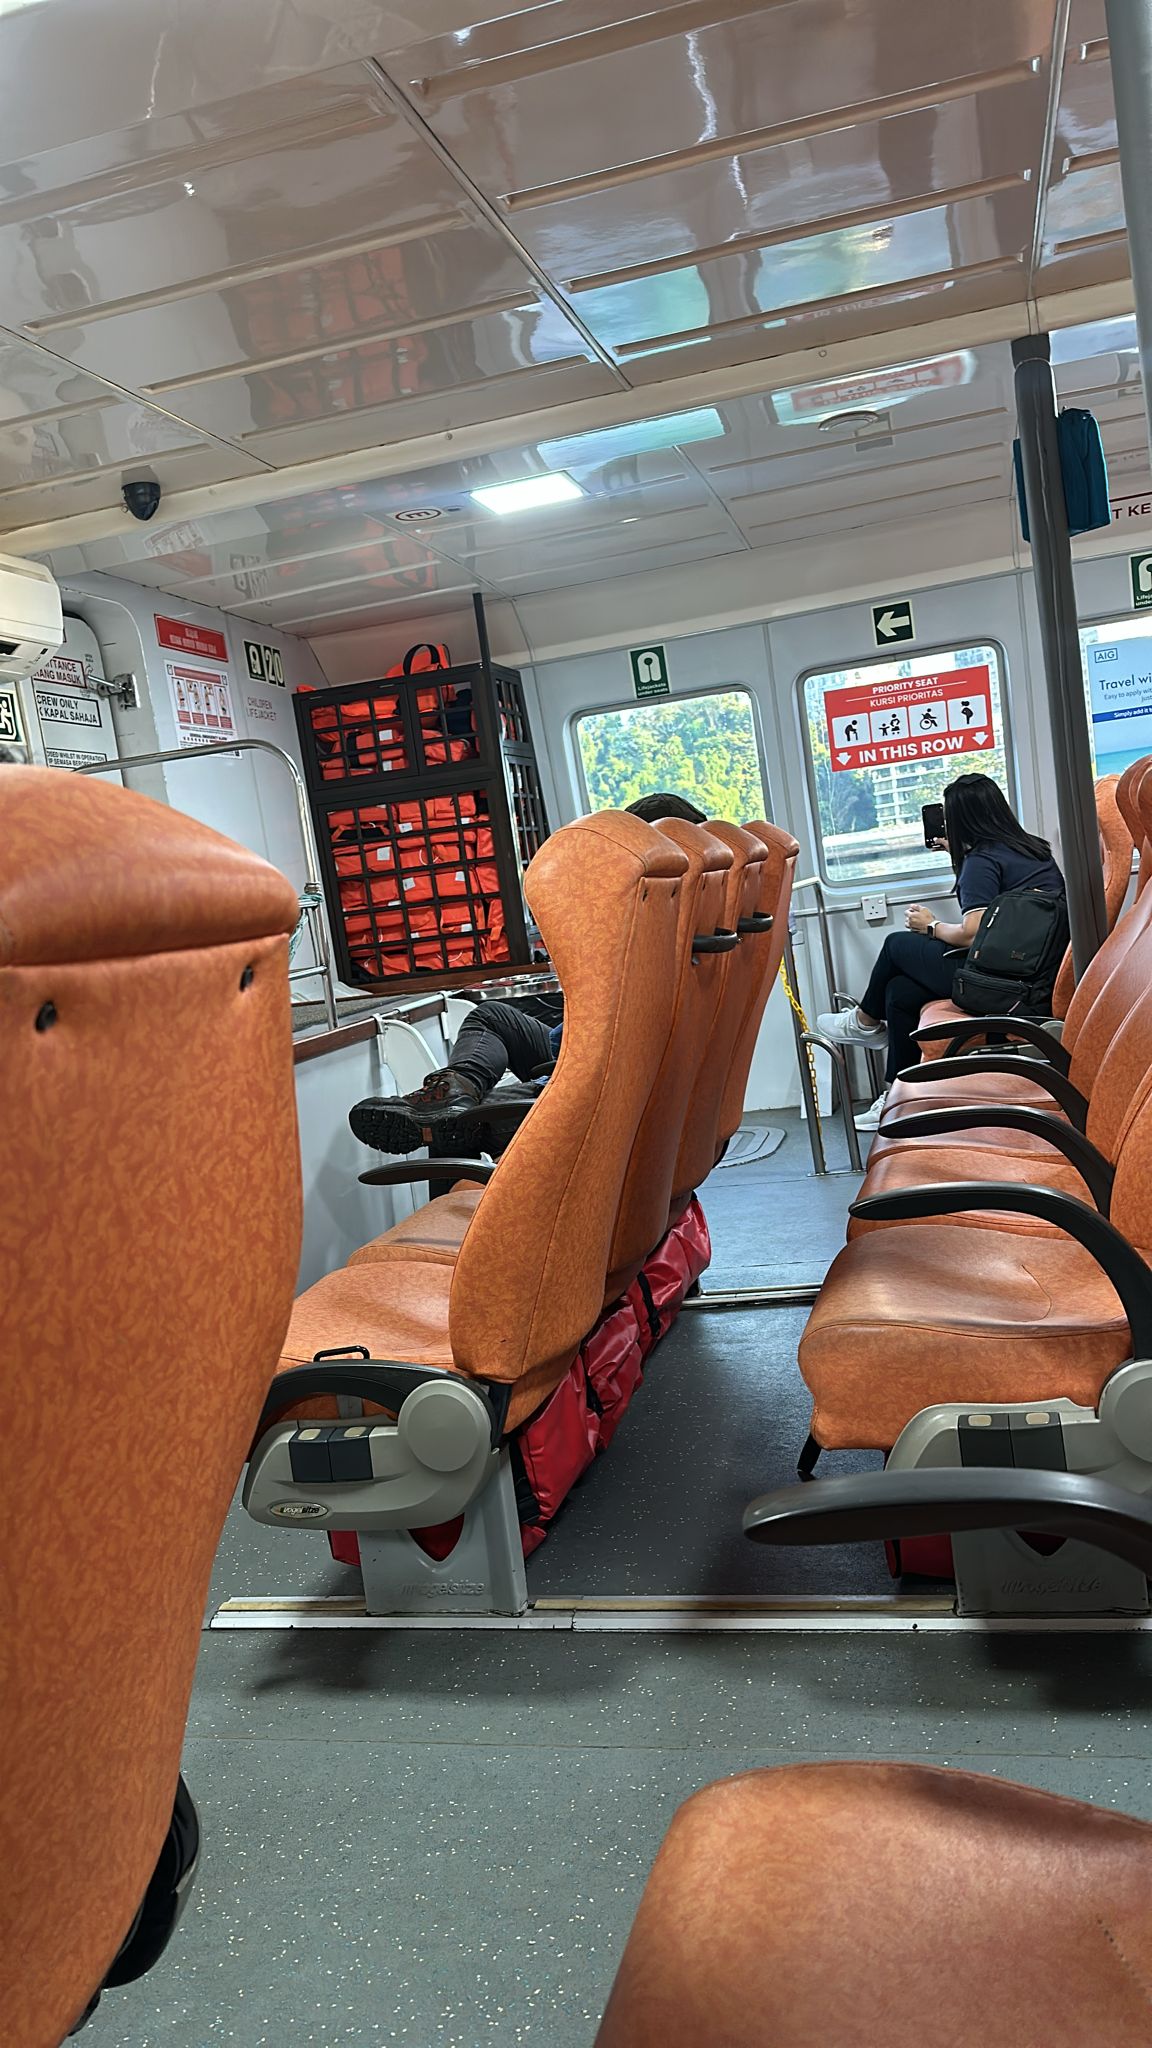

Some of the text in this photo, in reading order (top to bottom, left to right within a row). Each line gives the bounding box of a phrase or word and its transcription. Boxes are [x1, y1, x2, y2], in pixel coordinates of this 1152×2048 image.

[1128, 502, 1152, 517] KE
[1097, 650, 1115, 660] AIG
[265, 649, 284, 684] 20
[56, 671, 82, 685] MASUK
[872, 677, 938, 694] PRIORITY SEAT
[1099, 672, 1152, 690] Travel wi
[870, 689, 944, 708] KURSI PRIORITAS
[1126, 689, 1142, 697] apply
[36, 694, 79, 710] CREW ONLY
[44, 707, 69, 720] KAPAL
[70, 711, 98, 724] SAHAJA
[1113, 710, 1133, 718] Simply
[859, 736, 964, 764] IN THIS ROW
